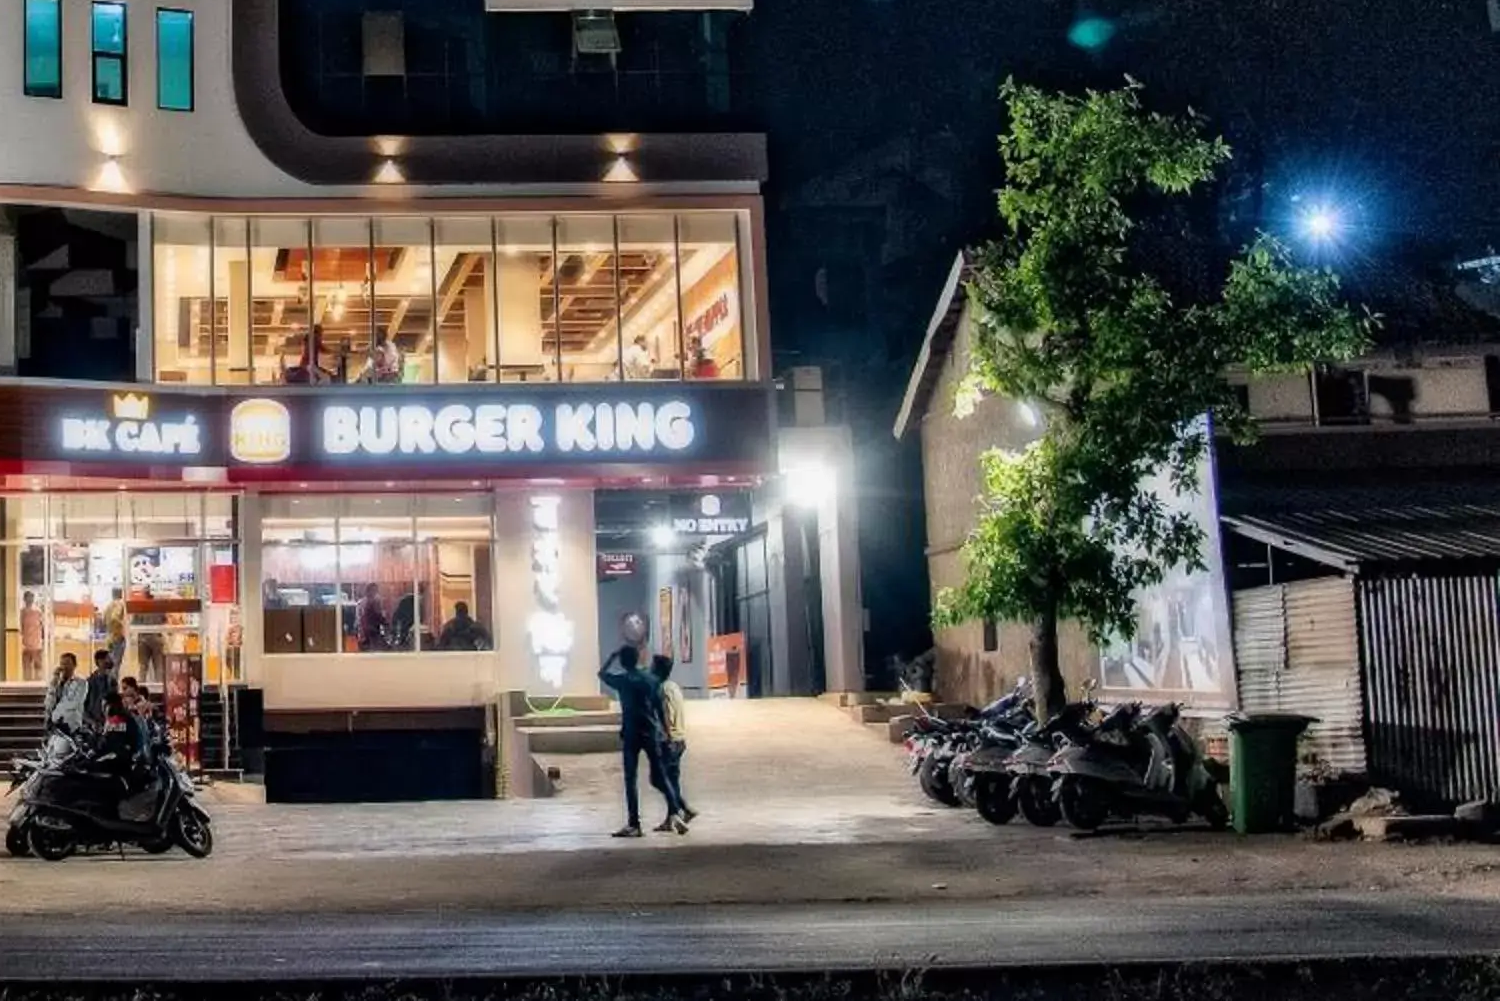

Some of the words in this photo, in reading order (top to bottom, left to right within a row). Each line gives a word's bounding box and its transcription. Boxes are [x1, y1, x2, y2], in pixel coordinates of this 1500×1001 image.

[62, 418, 111, 450] BK
[323, 404, 545, 454] BURGER
[555, 401, 695, 451] KING
[673, 518, 697, 532] NO
[699, 518, 749, 532] ENTRY
